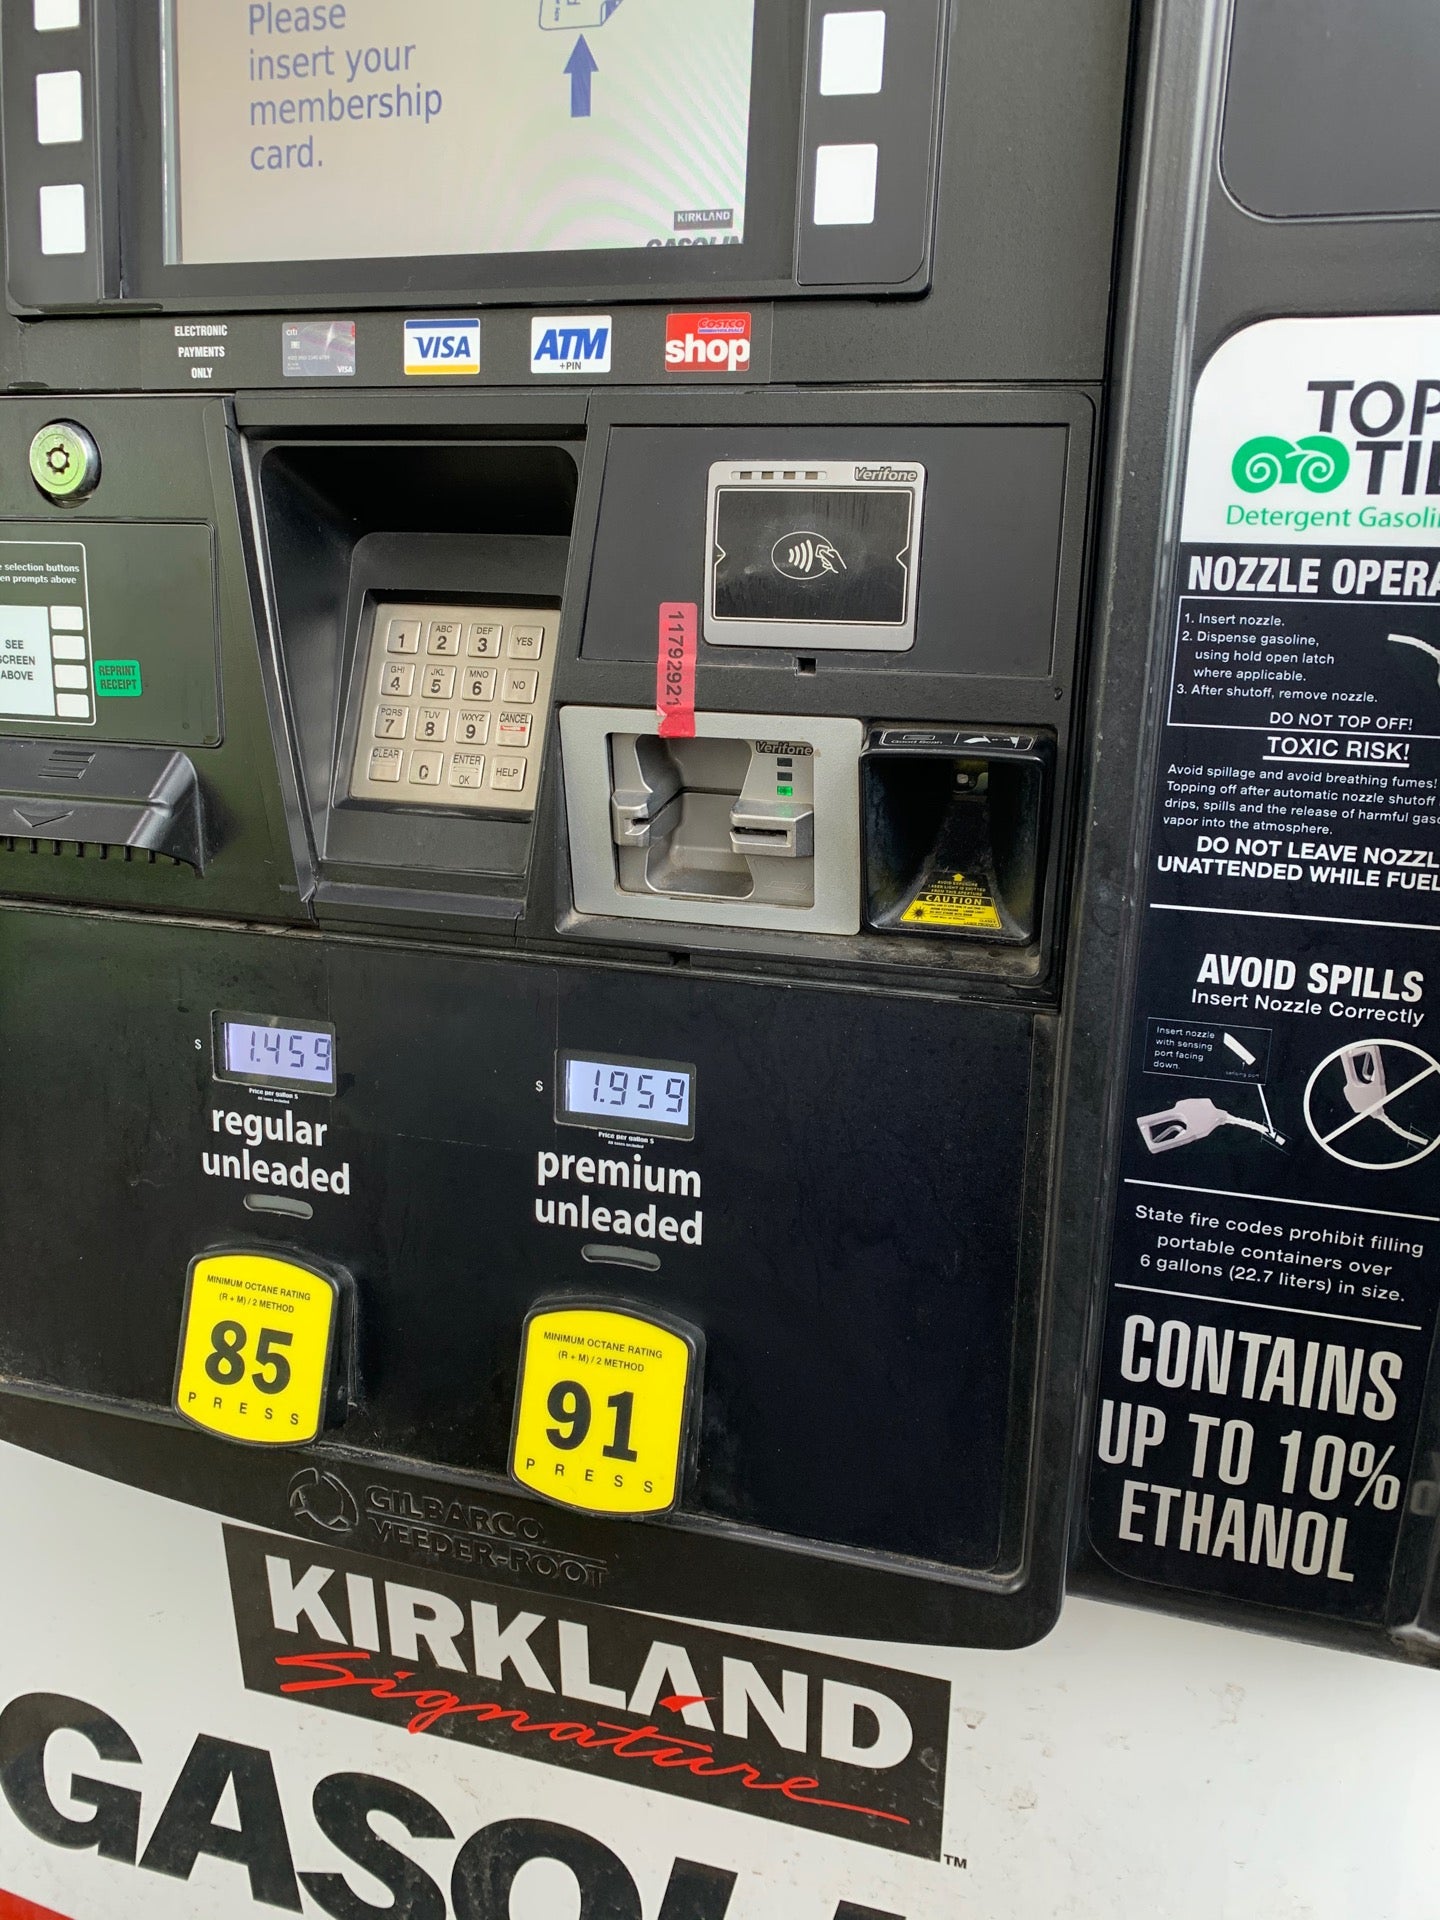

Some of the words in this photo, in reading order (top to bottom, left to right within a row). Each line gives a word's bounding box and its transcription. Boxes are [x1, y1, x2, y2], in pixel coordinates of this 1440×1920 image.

[248, 3, 347, 35] Please
[249, 45, 335, 81] insert
[346, 43, 416, 83] your
[249, 82, 442, 126] membership
[250, 135, 324, 171] card.
[677, 211, 731, 222] KIRKLAND
[174, 325, 228, 337] ELECTRONIC
[178, 346, 225, 358] PAYMENTS
[416, 336, 471, 359] VISA
[533, 328, 609, 361] ATM
[665, 333, 750, 371] shop
[191, 368, 213, 379] ONLY
[559, 361, 582, 371] +PIN
[1307, 379, 1440, 437] TOP
[854, 467, 919, 483] Verifone
[1226, 505, 1352, 532] Detergent
[5, 563, 44, 572] selection
[46, 563, 80, 573] buttons
[1187, 555, 1322, 593] NOZZLE
[13, 575, 49, 585] prompts
[50, 576, 77, 585] above
[1184, 613, 1195, 624] 1.
[1199, 613, 1236, 625] Insert
[1240, 614, 1285, 627] nozzle.
[5, 639, 25, 650] SEE
[398, 634, 405, 648] 1
[437, 636, 447, 650] 2
[477, 638, 488, 652] 3
[516, 637, 533, 647] YES
[1182, 631, 1193, 642] 2.
[1197, 631, 1257, 646] Dispense
[1260, 633, 1320, 648] gasoline,
[665, 610, 684, 706] 11792921
[1195, 650, 1230, 663] using
[1233, 650, 1262, 662] hold
[1265, 653, 1298, 666] open
[1302, 652, 1335, 665] latch
[1, 670, 34, 681] ABOVE
[99, 665, 137, 676] REPRINT
[1193, 668, 1233, 679] where
[1236, 669, 1307, 683] applicable.
[100, 679, 138, 690] RECEIPT
[390, 677, 401, 691] 4
[431, 679, 441, 694] 5
[472, 681, 482, 695] 6
[512, 680, 526, 690] NO
[1177, 684, 1188, 695] 3.
[1191, 685, 1223, 697] After
[1226, 686, 1275, 700] shutoff,
[1279, 689, 1328, 701] remove
[1331, 691, 1378, 703] nozzle.
[385, 718, 395, 733] 7
[499, 713, 529, 724] CANCEL
[1269, 711, 1294, 725] DO
[1298, 712, 1334, 727] NOT
[1338, 715, 1371, 728] TOP
[1375, 716, 1413, 731] OFF!
[425, 721, 435, 737] 8
[466, 724, 476, 739] 9
[372, 749, 399, 759] CLEAR
[754, 741, 814, 756] Verifone
[1267, 736, 1340, 757] TOXIC
[1345, 740, 1410, 761] RISK!
[453, 754, 481, 766] ENTER
[458, 775, 470, 785] OK
[496, 767, 519, 777] HELP
[1167, 764, 1203, 776] Avoid
[1206, 766, 1256, 780] spillage
[1259, 769, 1283, 780] and
[1286, 770, 1322, 783] avoid
[1325, 772, 1388, 788] breathing
[1391, 774, 1438, 789] fumes!
[1167, 781, 1216, 796] Topping
[1220, 783, 1237, 794] off
[1240, 784, 1270, 797] after
[1273, 787, 1338, 801] automatic
[1342, 790, 1385, 804] nozzle
[1388, 794, 1436, 807] shutoff
[1164, 797, 1200, 811] drips,
[1203, 800, 1236, 814] spills
[1239, 802, 1264, 814] and
[1267, 803, 1287, 815] the
[1290, 804, 1338, 818] release
[1341, 807, 1356, 819] of
[1358, 808, 1409, 822] harmful
[1163, 815, 1198, 827] vapor
[1201, 816, 1226, 827] into
[1229, 818, 1250, 829] the
[1253, 820, 1333, 835] atmosphere.
[1197, 836, 1229, 854] DO
[1235, 838, 1283, 857] NOT
[1287, 841, 1358, 863] LEAVE
[1363, 847, 1440, 868] NOZZL
[1157, 855, 1303, 881] UNATTENDED
[1309, 865, 1381, 887] WHILE
[1387, 870, 1440, 892] FUEL
[925, 894, 982, 905] CAUTION
[1196, 953, 1297, 991] AVOID
[1306, 962, 1424, 1003] SPILLS
[1191, 988, 1249, 1008] Insert
[1254, 994, 1322, 1015] Nozzle
[1328, 1001, 1425, 1028] Correctly
[1156, 1026, 1183, 1036] Insert
[1185, 1030, 1215, 1039] nozzle
[250, 1031, 331, 1071] 1.459
[1177, 1040, 1213, 1051] sensing
[1153, 1060, 1180, 1070] down.
[1154, 1050, 1173, 1058] port
[1175, 1050, 1204, 1062] facing
[593, 1069, 685, 1113] 1.959
[212, 1109, 327, 1147] regular
[202, 1149, 350, 1195] unleaded
[537, 1151, 701, 1198] premium
[535, 1194, 703, 1246] unleaded
[1135, 1204, 1184, 1225] State
[1189, 1212, 1220, 1229] fire
[1225, 1217, 1284, 1237] codes
[1289, 1225, 1365, 1249] prohibit
[1370, 1234, 1424, 1258] filling
[1157, 1234, 1235, 1256] portable
[1241, 1244, 1343, 1271] containers
[1348, 1259, 1393, 1277] over
[206, 1274, 243, 1289] MINIMUM
[244, 1281, 278, 1295] OCTANE
[280, 1287, 311, 1301] RATING
[1139, 1253, 1151, 1268] 6
[1156, 1256, 1223, 1277] gallons
[1228, 1264, 1274, 1285] (22.7
[1279, 1271, 1333, 1295] liters)
[1338, 1279, 1355, 1295] in
[1361, 1283, 1405, 1303] size.
[543, 1331, 585, 1346] MINIMUM
[587, 1338, 625, 1353] OCTANE
[627, 1345, 663, 1359] RATING
[204, 1320, 294, 1395] 85
[1120, 1314, 1402, 1421] CONTAINS
[546, 1379, 638, 1463] 91
[1097, 1398, 1166, 1468] UP
[1188, 1412, 1254, 1485] TO
[1279, 1430, 1401, 1511] 10%
[365, 1485, 546, 1541] GILBARCO
[1118, 1479, 1355, 1582] ETHANOL
[366, 1516, 608, 1587] VEEDER-ROOT
[264, 1555, 914, 1771] KIRKLAND
[275, 1650, 911, 1825] Signature
